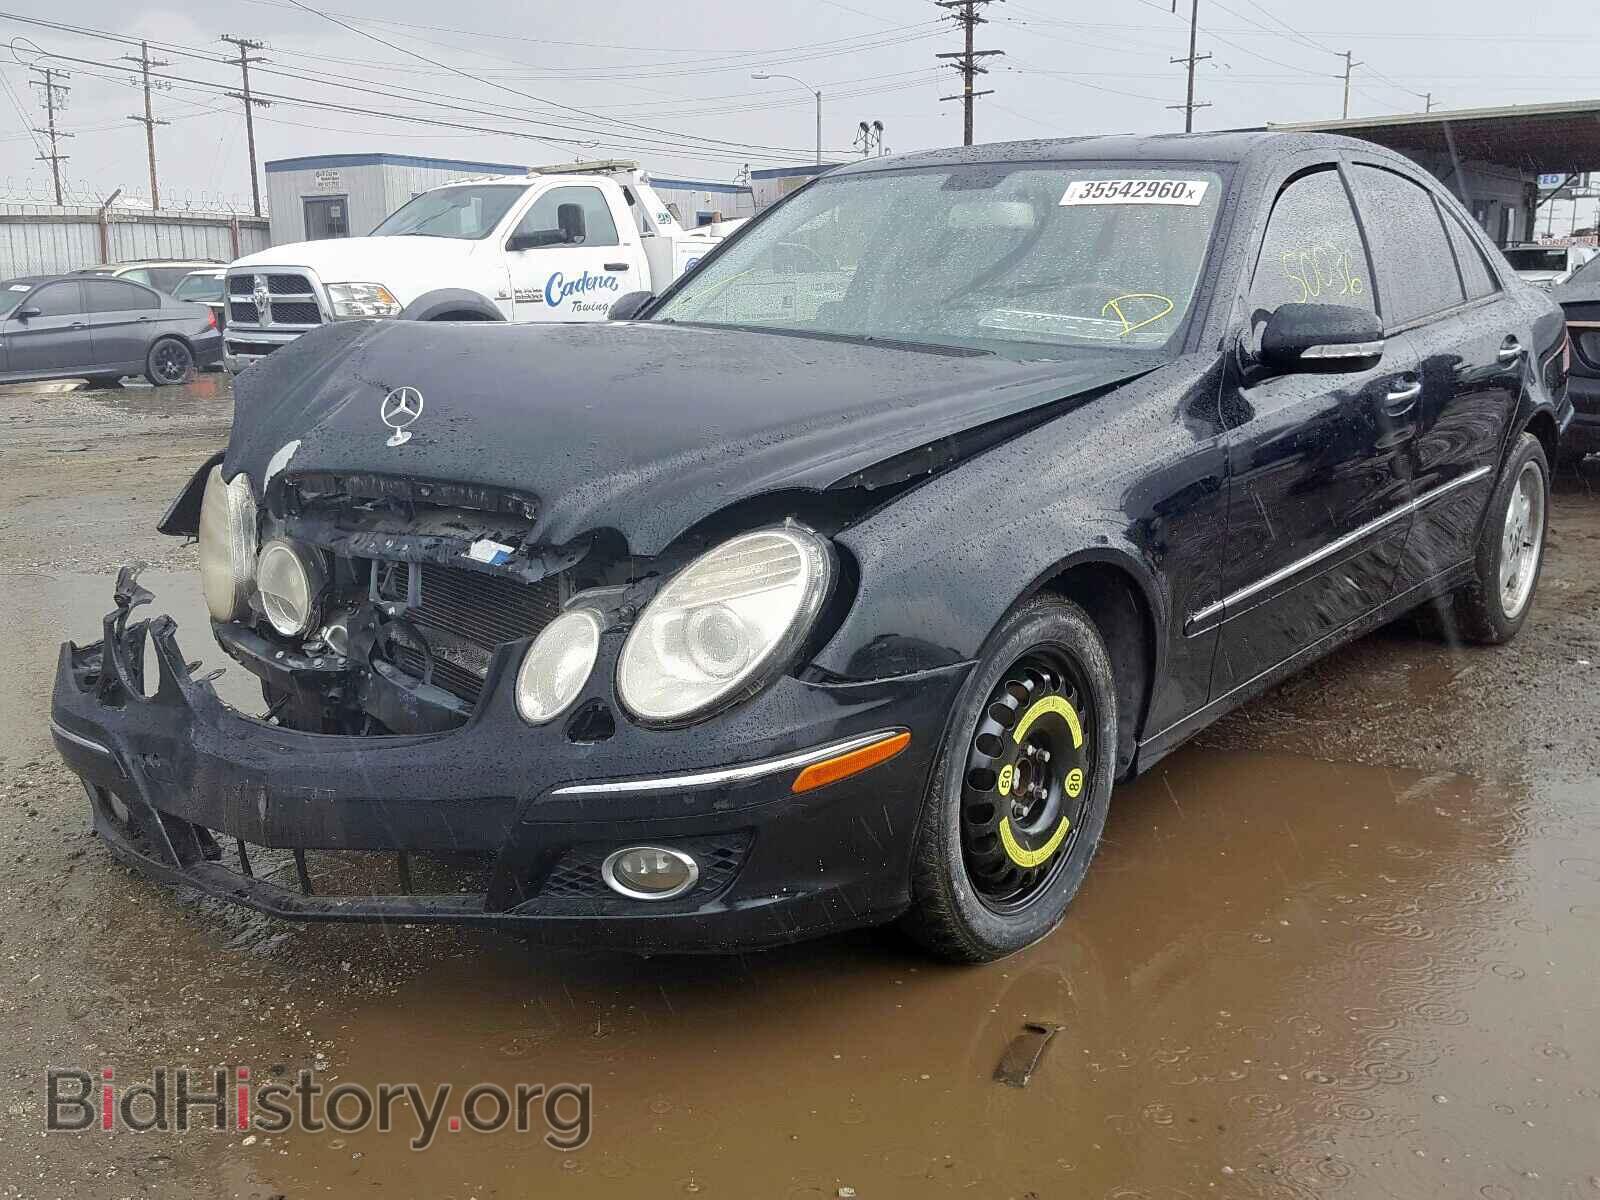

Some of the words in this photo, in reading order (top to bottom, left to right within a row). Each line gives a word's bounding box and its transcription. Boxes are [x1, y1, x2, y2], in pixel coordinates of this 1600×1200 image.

[1079, 181, 1187, 199] 35542960
[544, 270, 619, 307] Cadena
[571, 301, 609, 316] Towing
[1001, 769, 1012, 789] 50
[1069, 772, 1081, 792] 80
